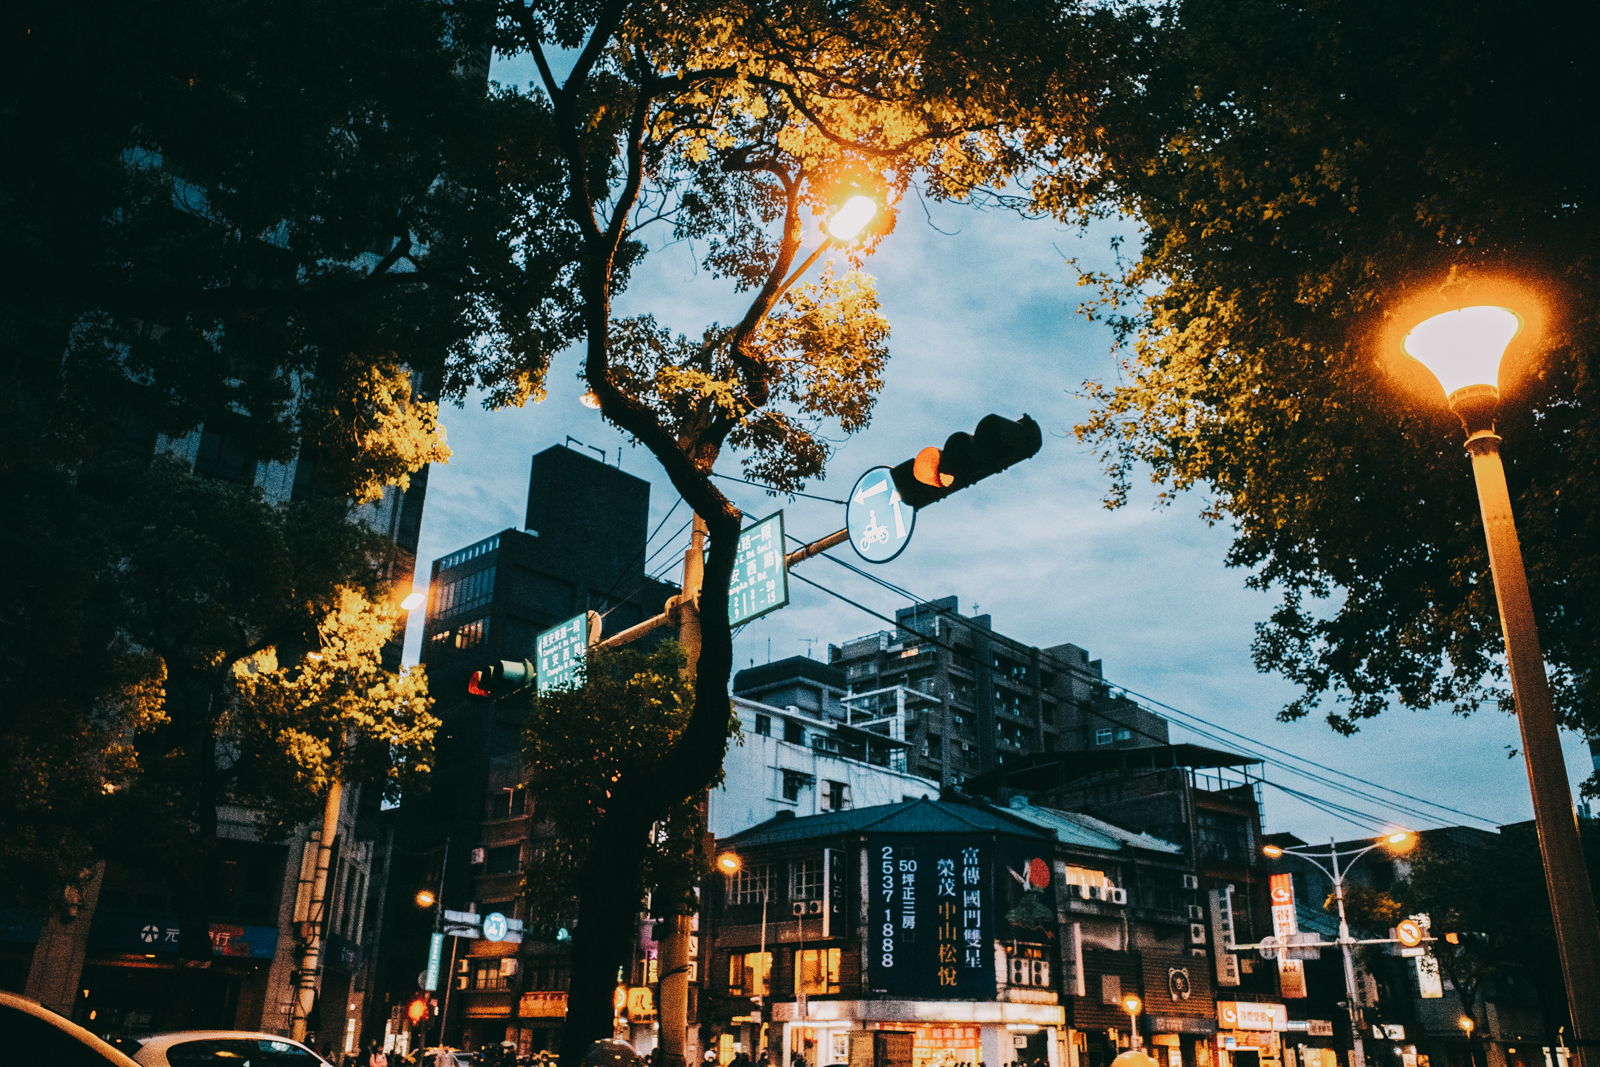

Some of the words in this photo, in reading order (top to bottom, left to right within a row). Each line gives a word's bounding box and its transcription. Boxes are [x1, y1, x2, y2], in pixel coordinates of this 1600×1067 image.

[746, 549, 756, 561] Rd.
[730, 551, 774, 586] 安西路
[164, 927, 180, 943] 元
[937, 901, 957, 987] 中山松悅
